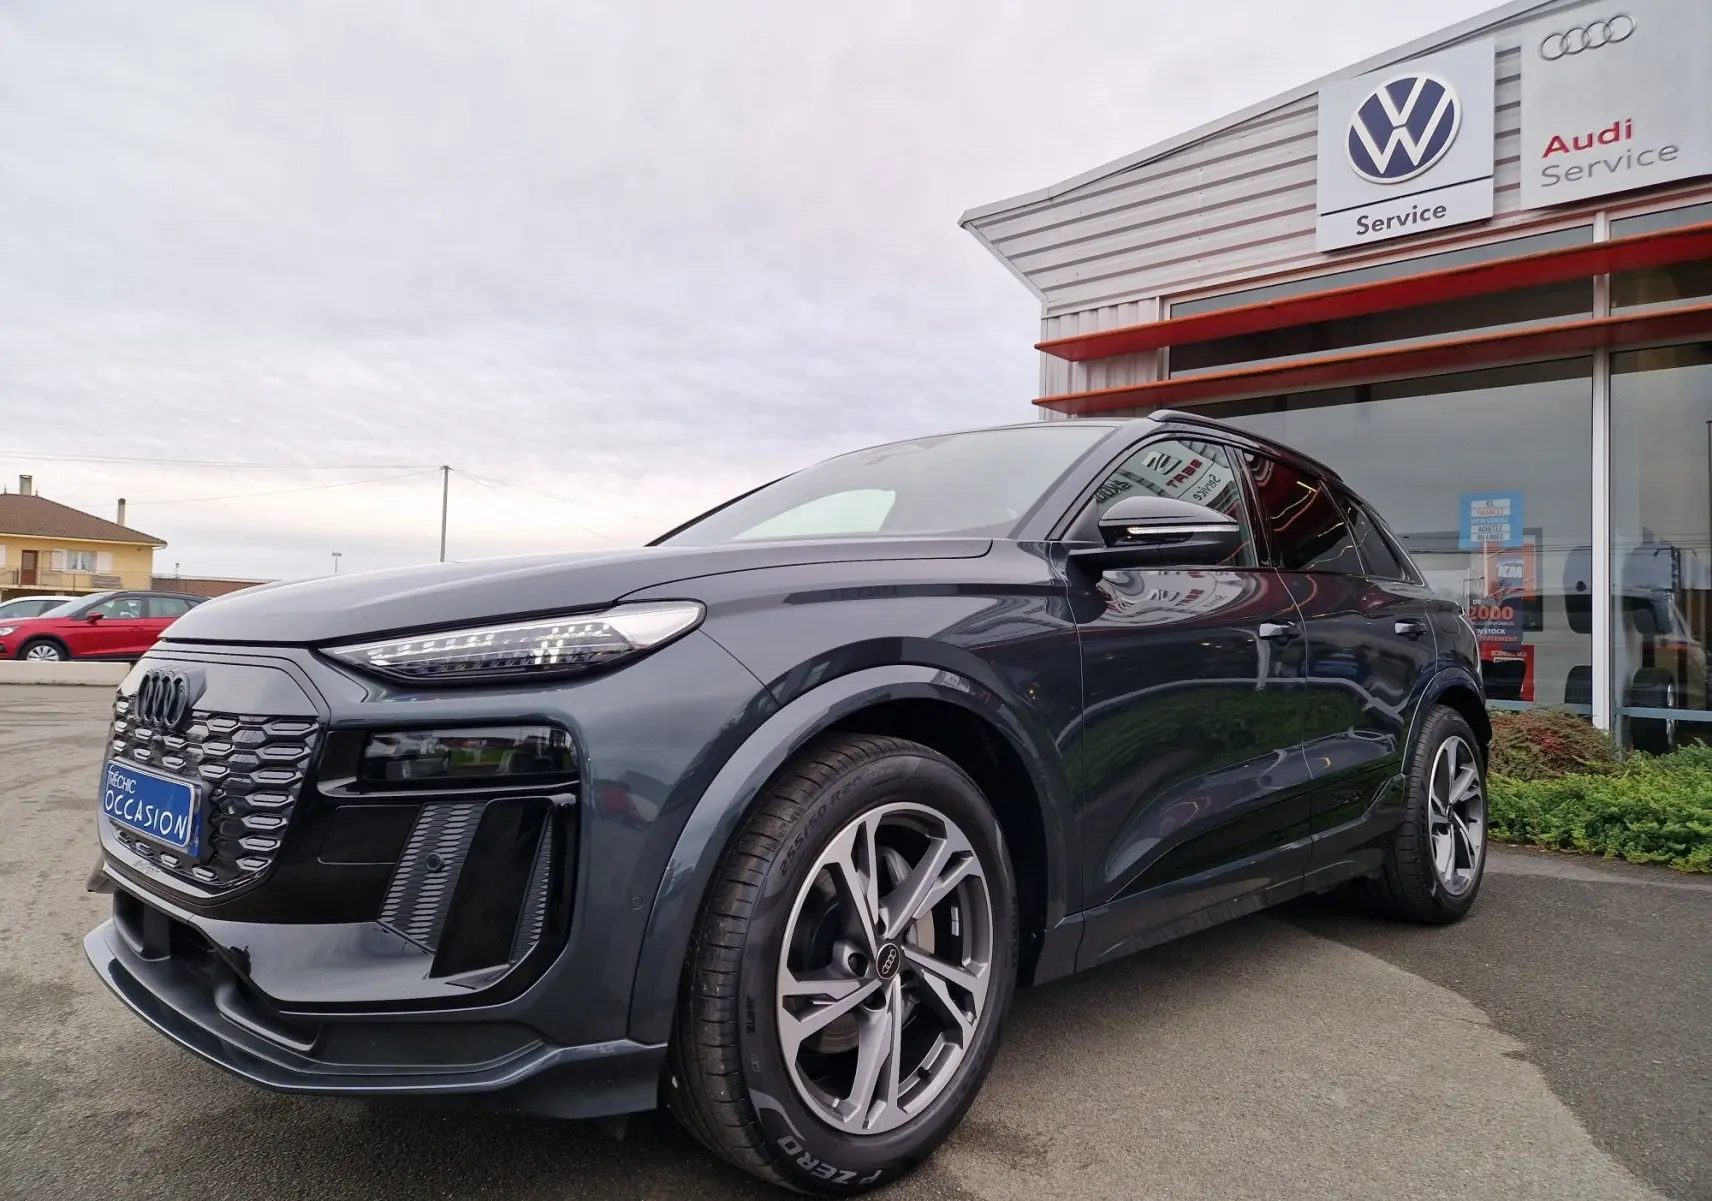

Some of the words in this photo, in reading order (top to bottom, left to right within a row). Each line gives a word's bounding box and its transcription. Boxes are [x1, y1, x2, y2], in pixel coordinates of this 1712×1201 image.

[1541, 118, 1633, 158] Audi
[1540, 144, 1681, 187] Service
[1356, 204, 1447, 236] Service
[1469, 605, 1514, 620] 2000
[104, 789, 188, 840] OCCASION
[777, 1135, 858, 1184] ZERO
